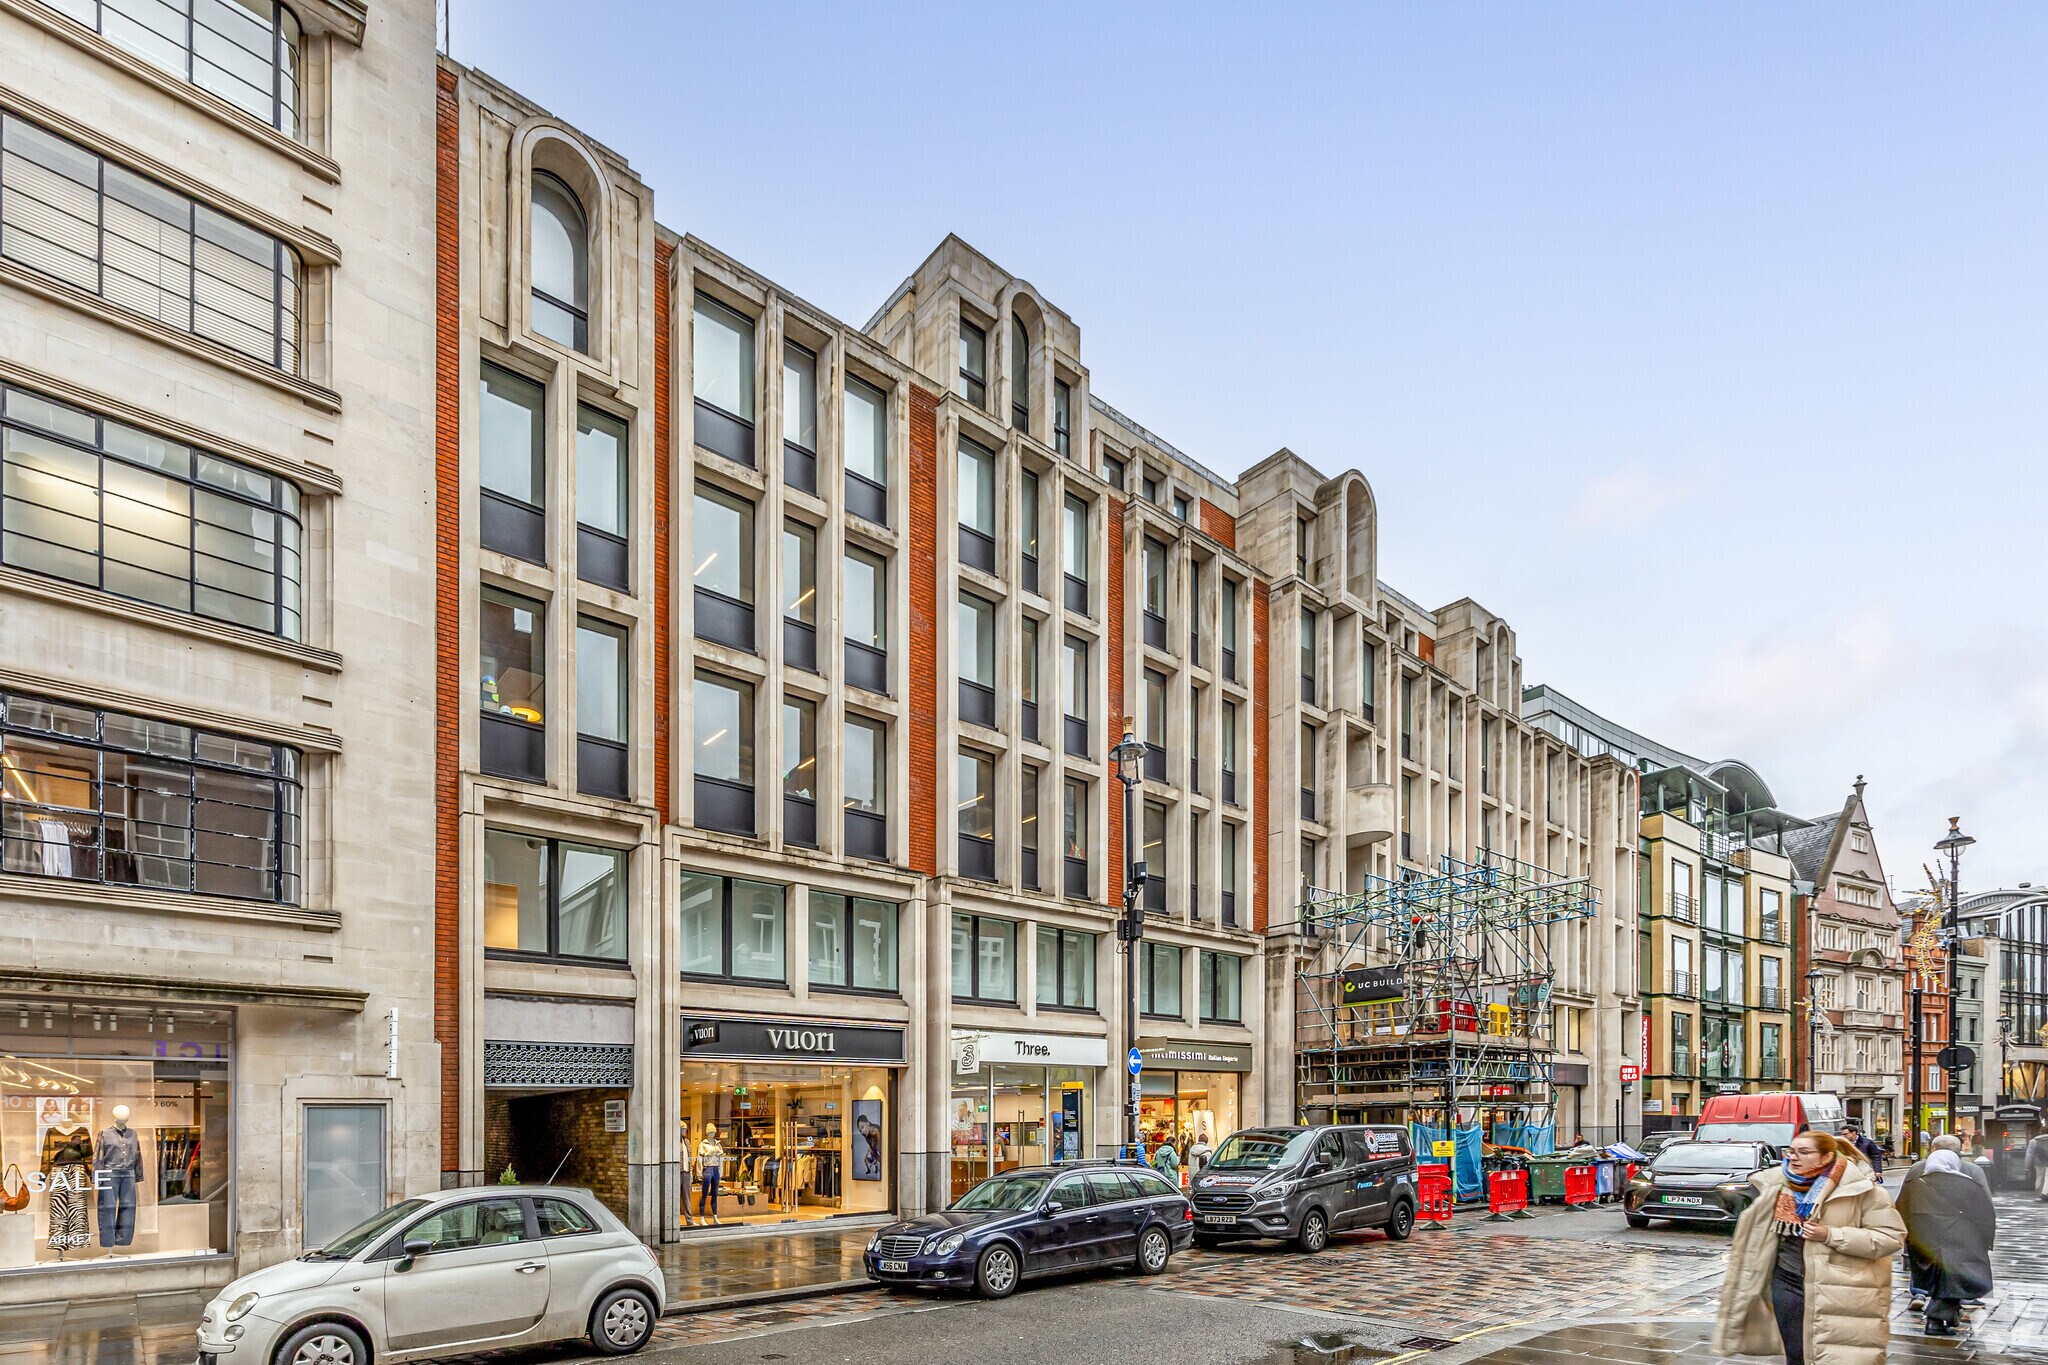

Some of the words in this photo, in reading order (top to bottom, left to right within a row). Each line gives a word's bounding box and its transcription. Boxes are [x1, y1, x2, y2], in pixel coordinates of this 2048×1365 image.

[1358, 981, 1371, 989] UC
[767, 1028, 836, 1052] vuori
[1014, 1041, 1051, 1056] Three.
[160, 1100, 178, 1108] 60%
[27, 1168, 113, 1194] SALE
[48, 1233, 94, 1246] ARKET
